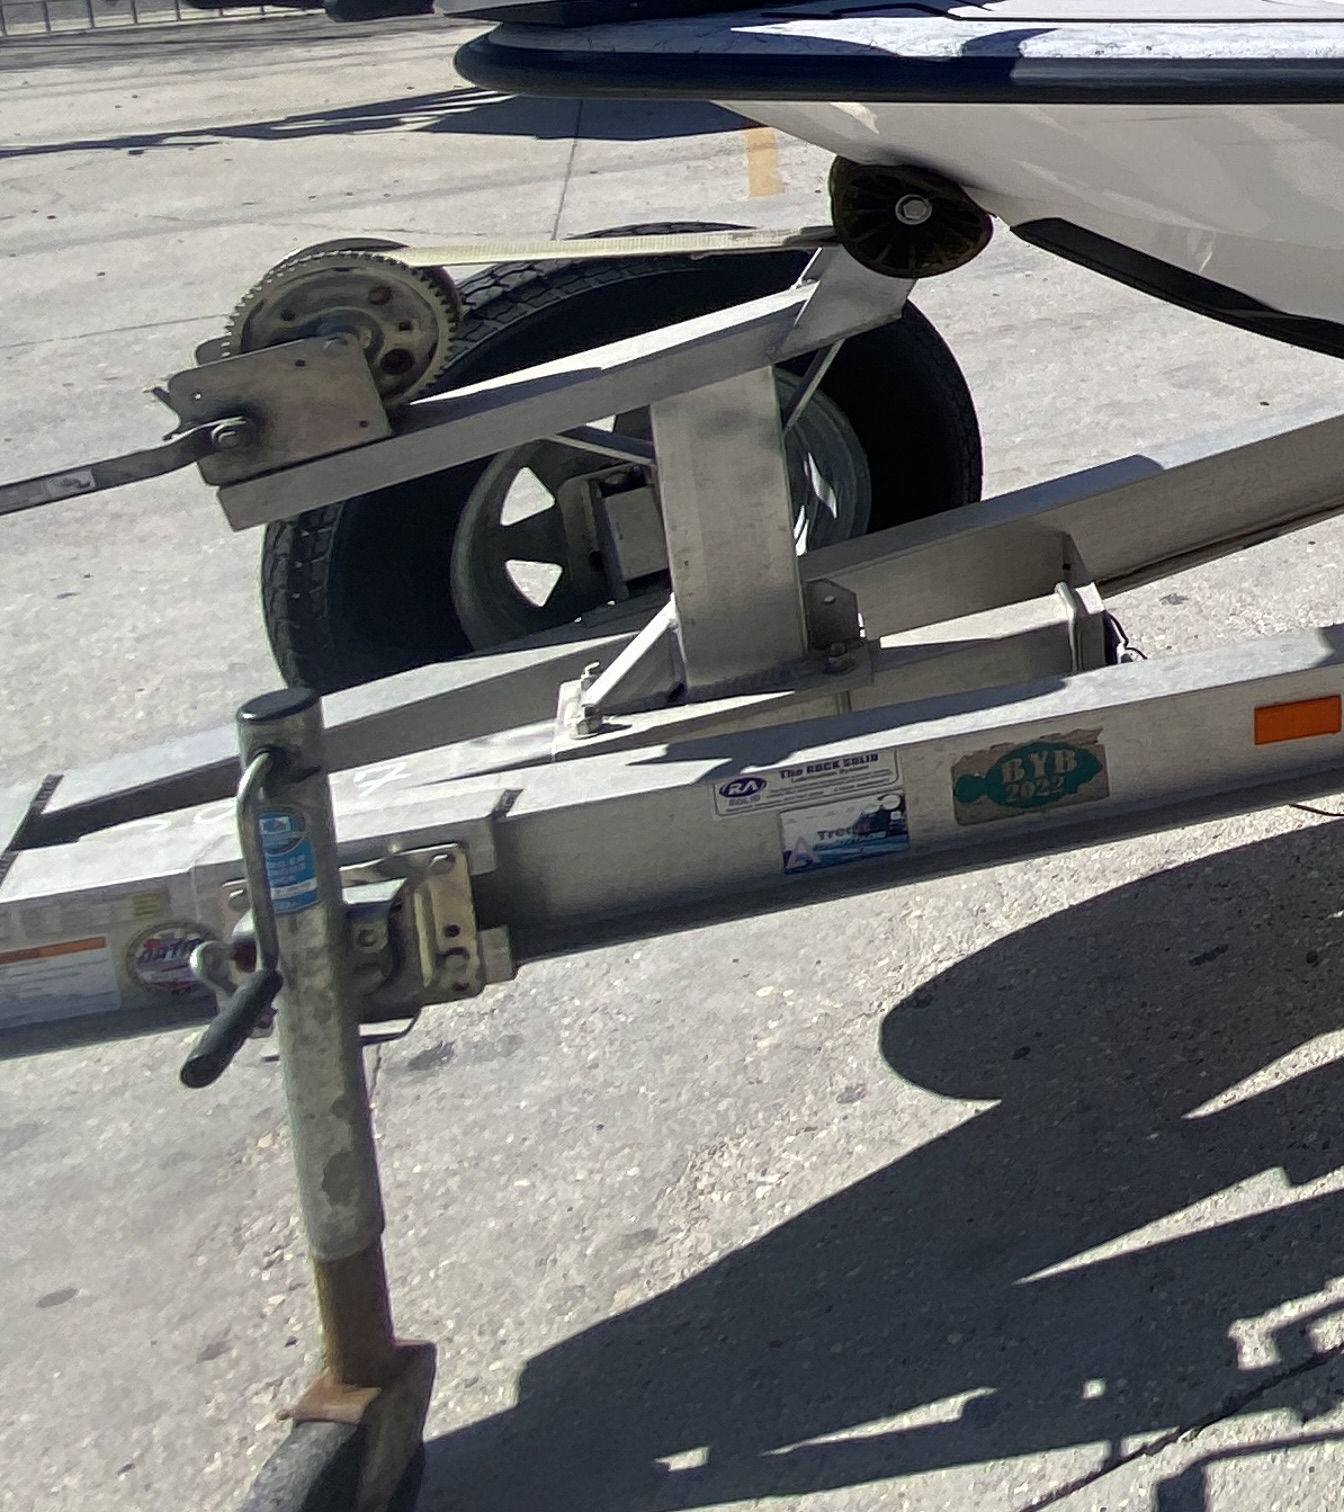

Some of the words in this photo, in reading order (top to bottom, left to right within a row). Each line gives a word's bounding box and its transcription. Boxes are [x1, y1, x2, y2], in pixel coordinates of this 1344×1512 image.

[806, 759, 841, 775] ROCK
[843, 753, 879, 768] SOLID
[1001, 749, 1078, 784] BYB
[1007, 775, 1065, 803] 2022
